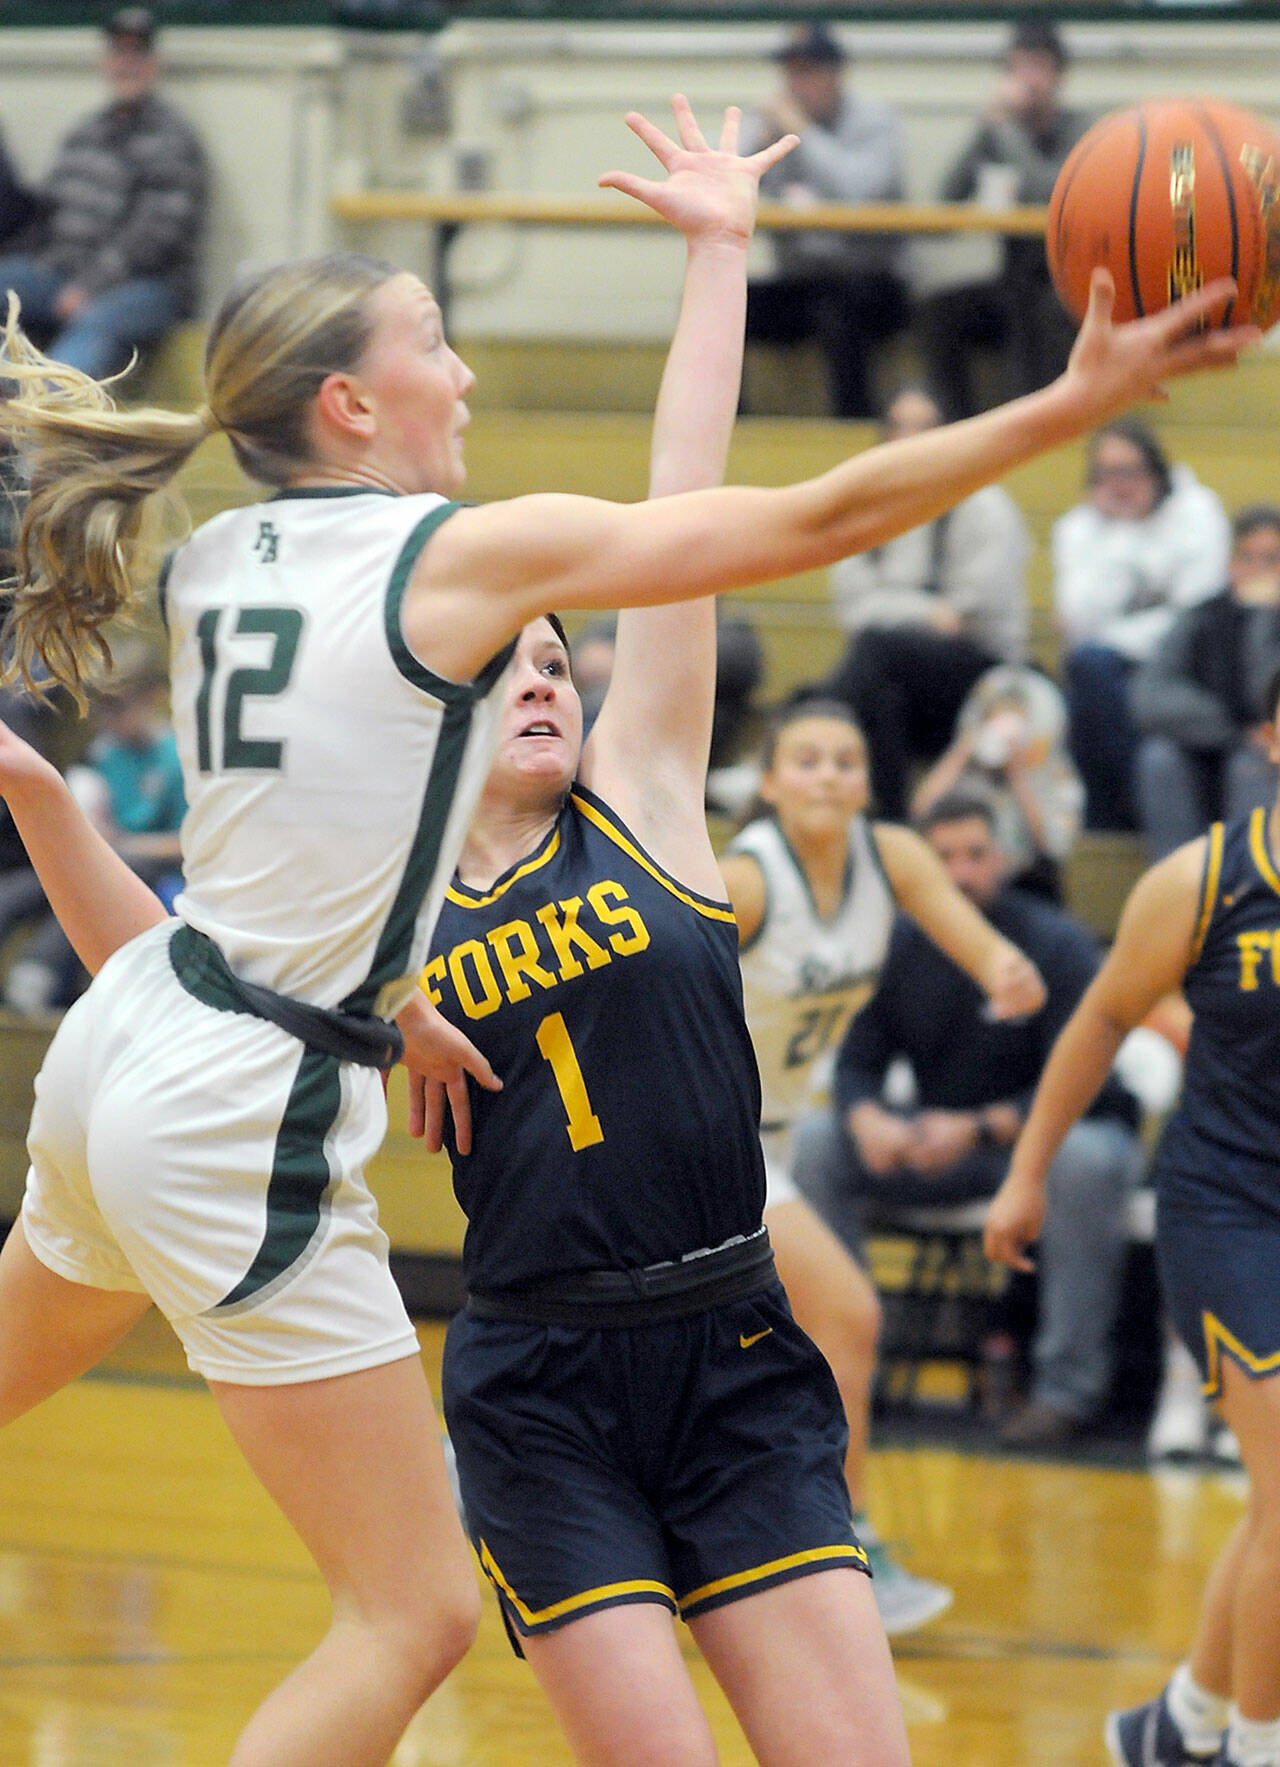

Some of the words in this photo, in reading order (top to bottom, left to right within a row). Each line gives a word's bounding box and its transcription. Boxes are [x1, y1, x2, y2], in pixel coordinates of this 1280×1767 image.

[195, 607, 305, 772] 12
[418, 879, 651, 1020] FORKS
[535, 1011, 605, 1152] 1
